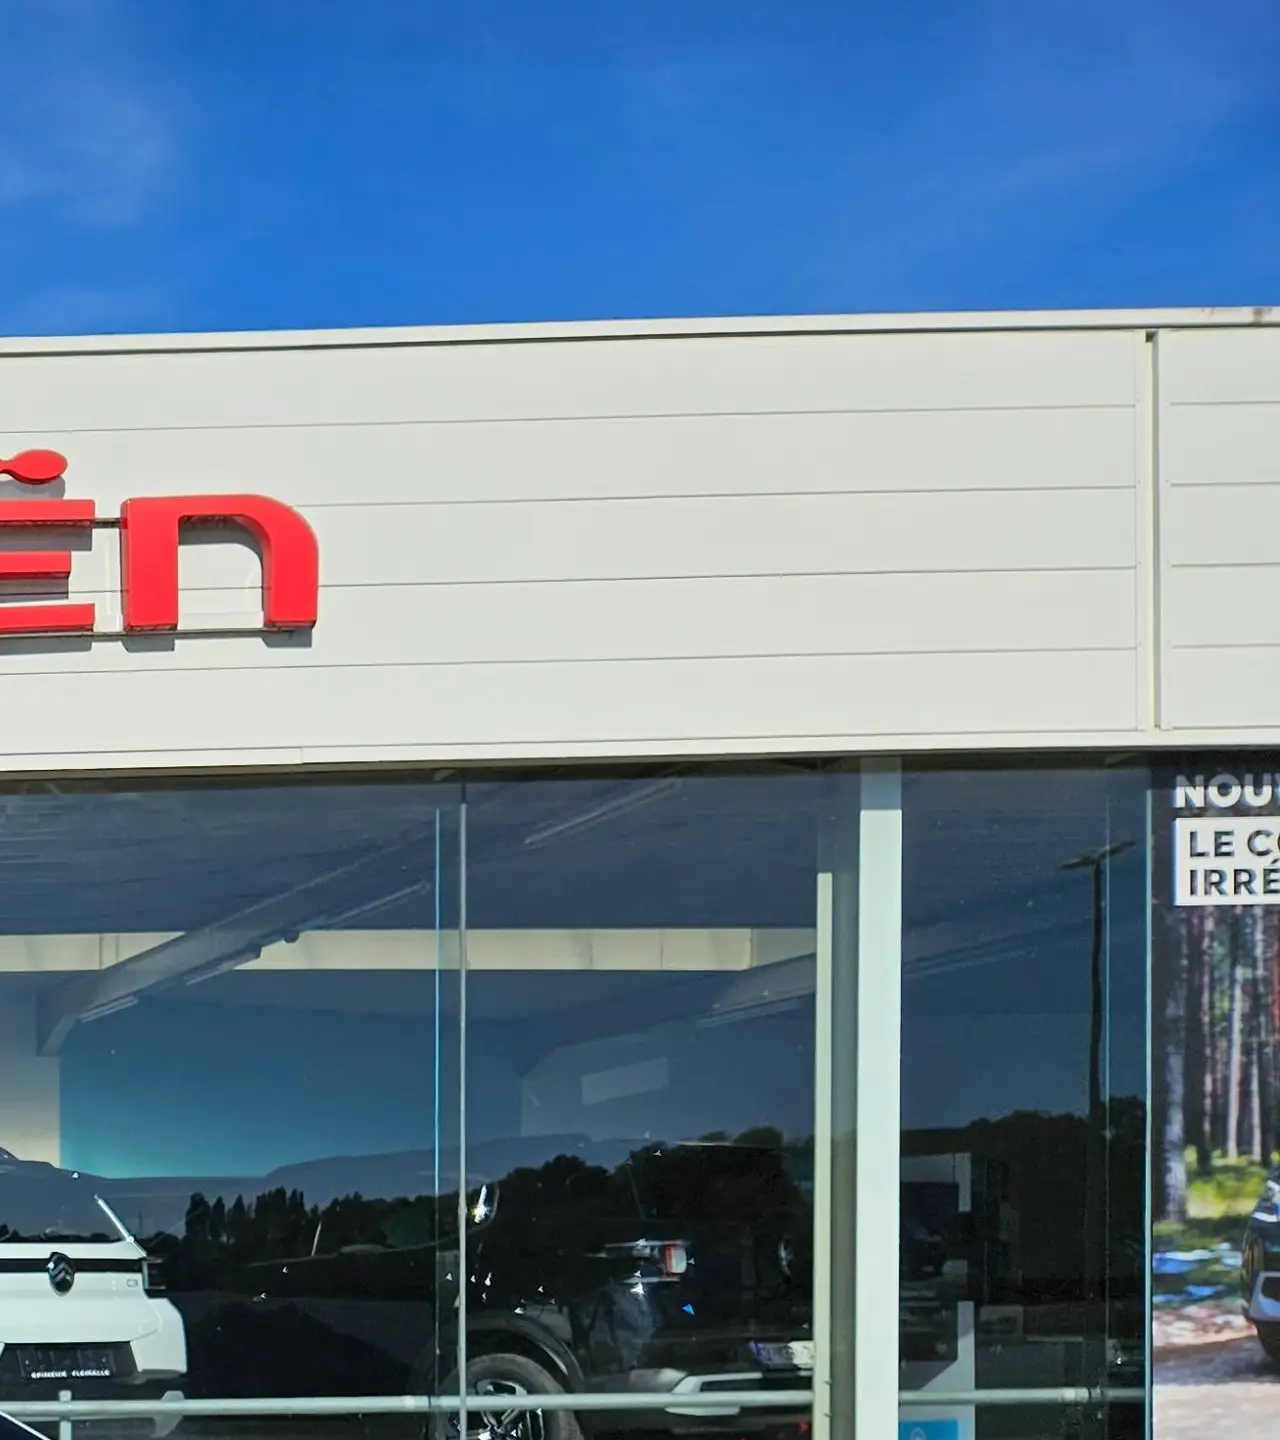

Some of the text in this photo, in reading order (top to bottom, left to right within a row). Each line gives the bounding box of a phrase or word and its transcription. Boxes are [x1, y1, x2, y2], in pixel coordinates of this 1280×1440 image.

[1175, 774, 1280, 807] NOU
[1189, 829, 1280, 858] LE C
